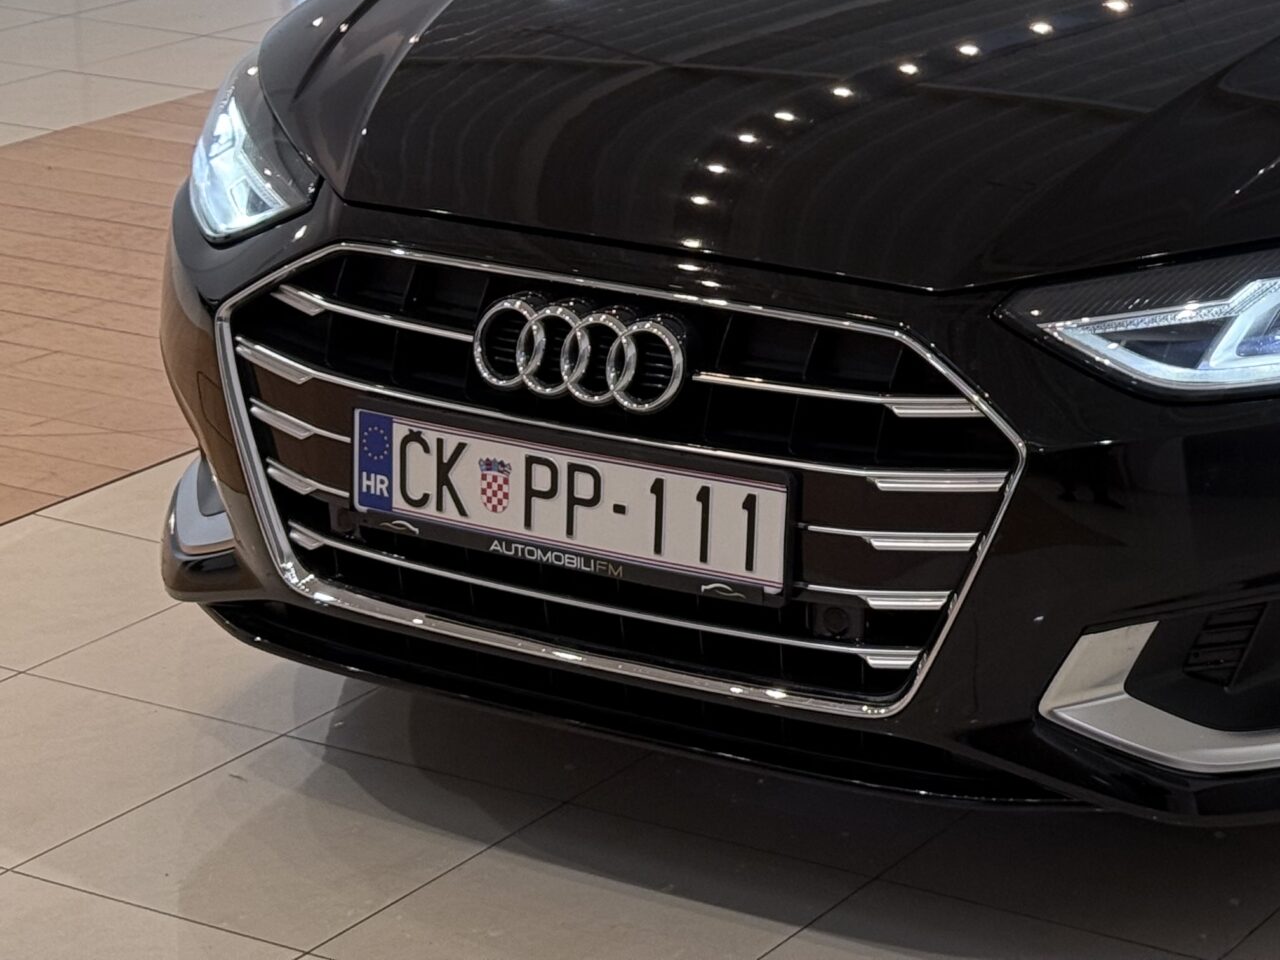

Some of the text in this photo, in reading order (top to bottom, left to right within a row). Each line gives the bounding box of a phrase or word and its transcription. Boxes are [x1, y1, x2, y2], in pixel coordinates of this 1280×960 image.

[361, 471, 389, 498] HR
[400, 428, 757, 572] ČK PP-111
